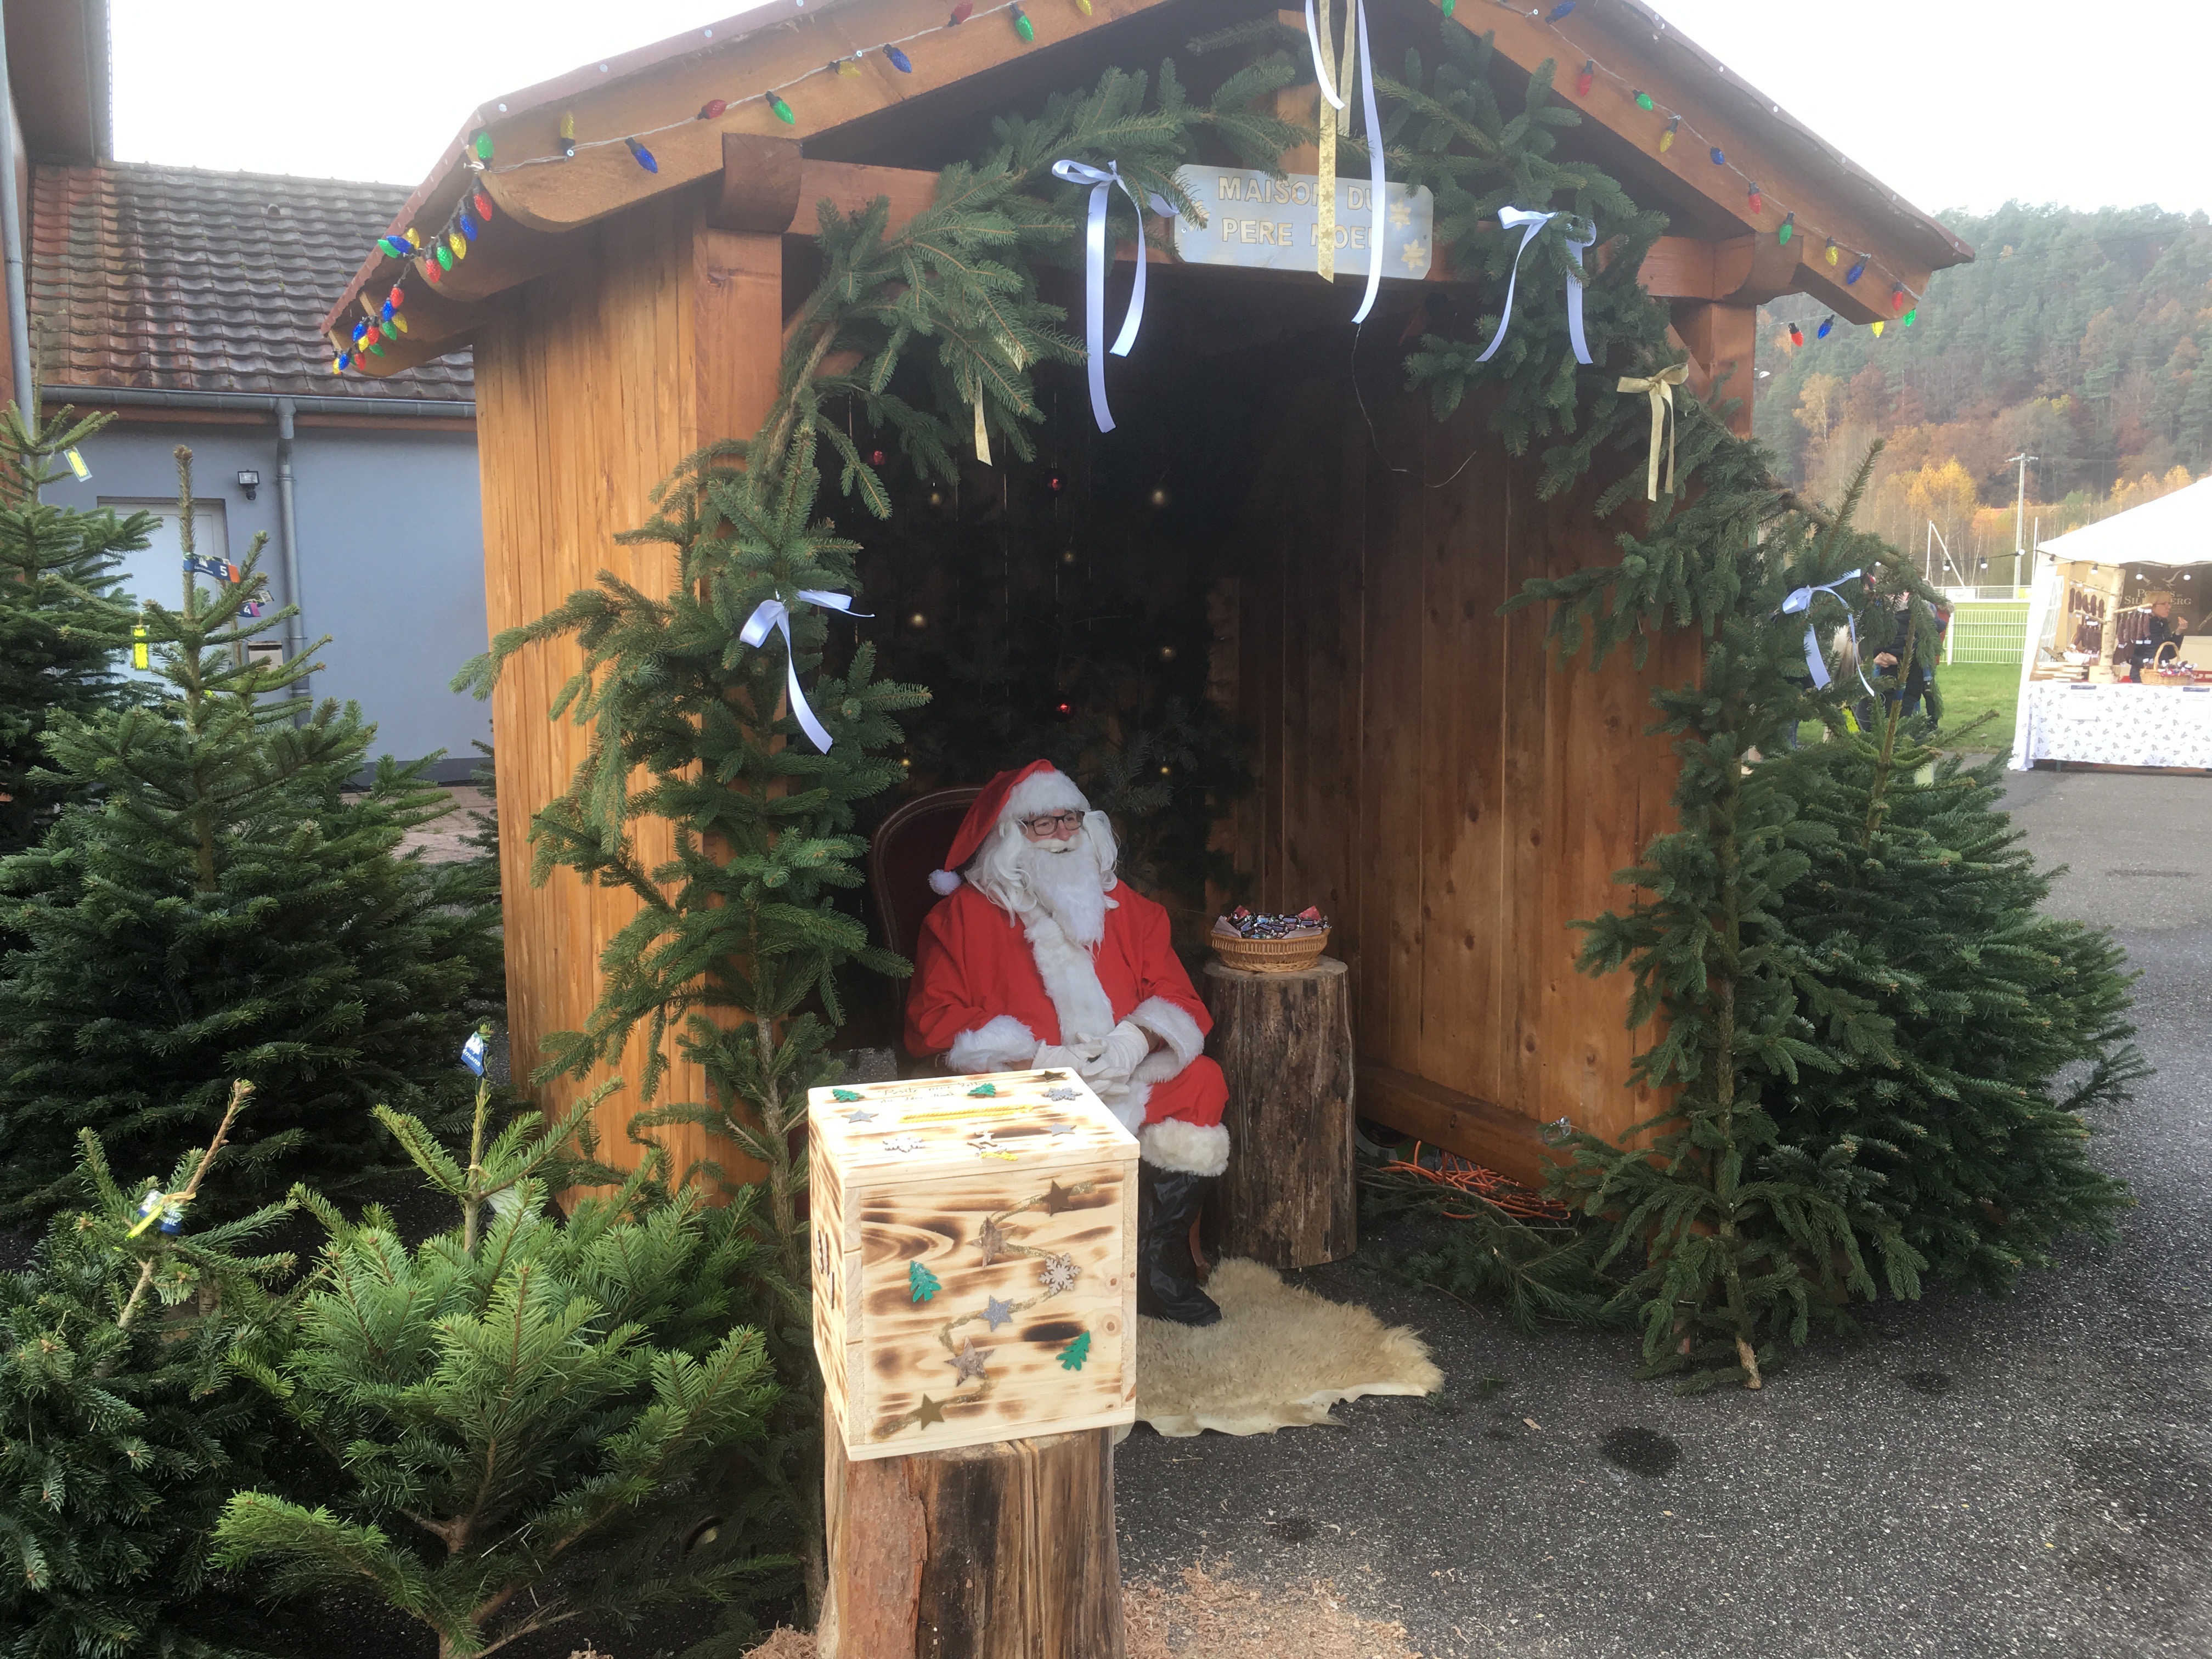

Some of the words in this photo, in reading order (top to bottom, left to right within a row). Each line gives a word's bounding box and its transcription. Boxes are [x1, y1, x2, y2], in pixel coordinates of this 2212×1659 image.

[1221, 217, 1293, 247] PERE
[220, 566, 228, 577] 5
[244, 605, 251, 614] 4
